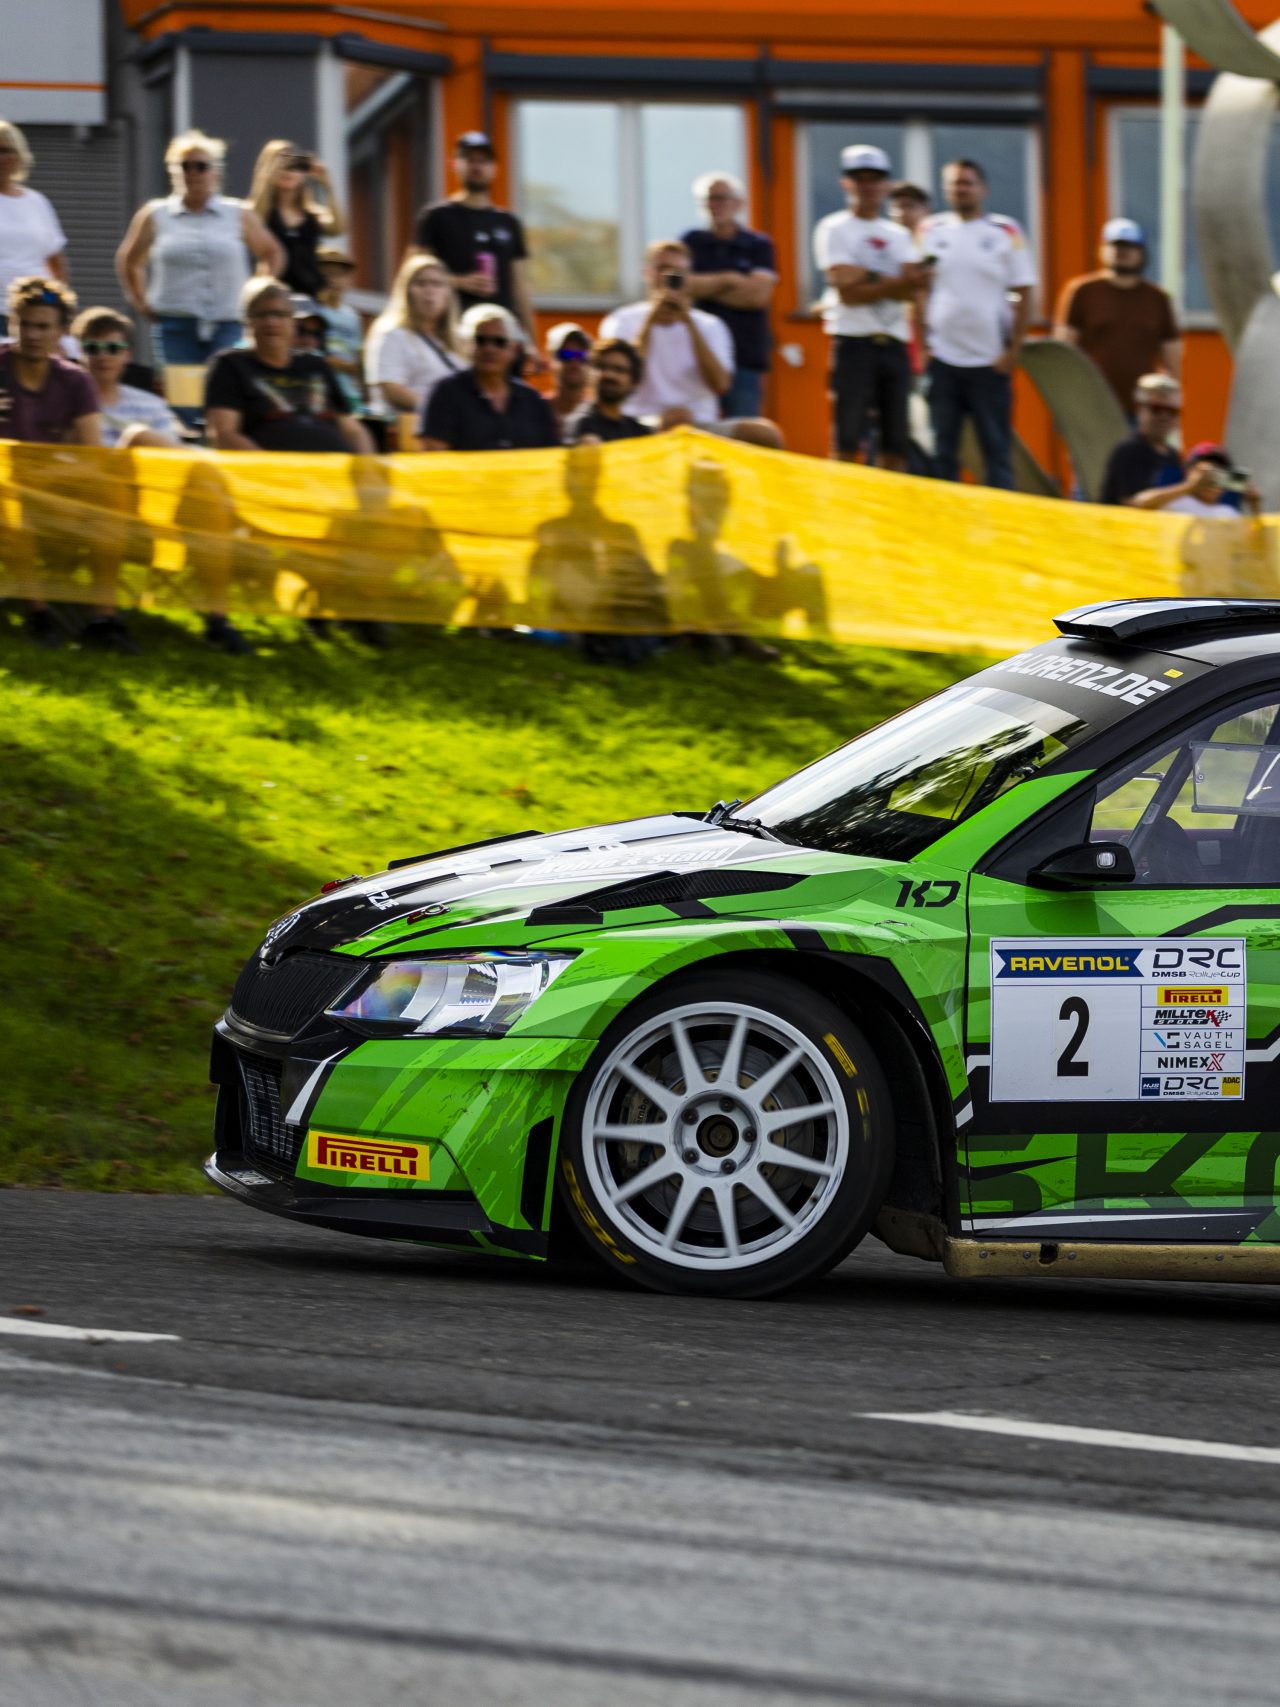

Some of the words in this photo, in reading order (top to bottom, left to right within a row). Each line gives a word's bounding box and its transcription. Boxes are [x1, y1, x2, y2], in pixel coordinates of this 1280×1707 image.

[1153, 948, 1240, 968] DRC
[1164, 989, 1222, 1003] PIRELLI
[1056, 995, 1090, 1077] 2
[1164, 1076, 1219, 1090] DRC
[317, 1135, 419, 1176] PIRELLI
